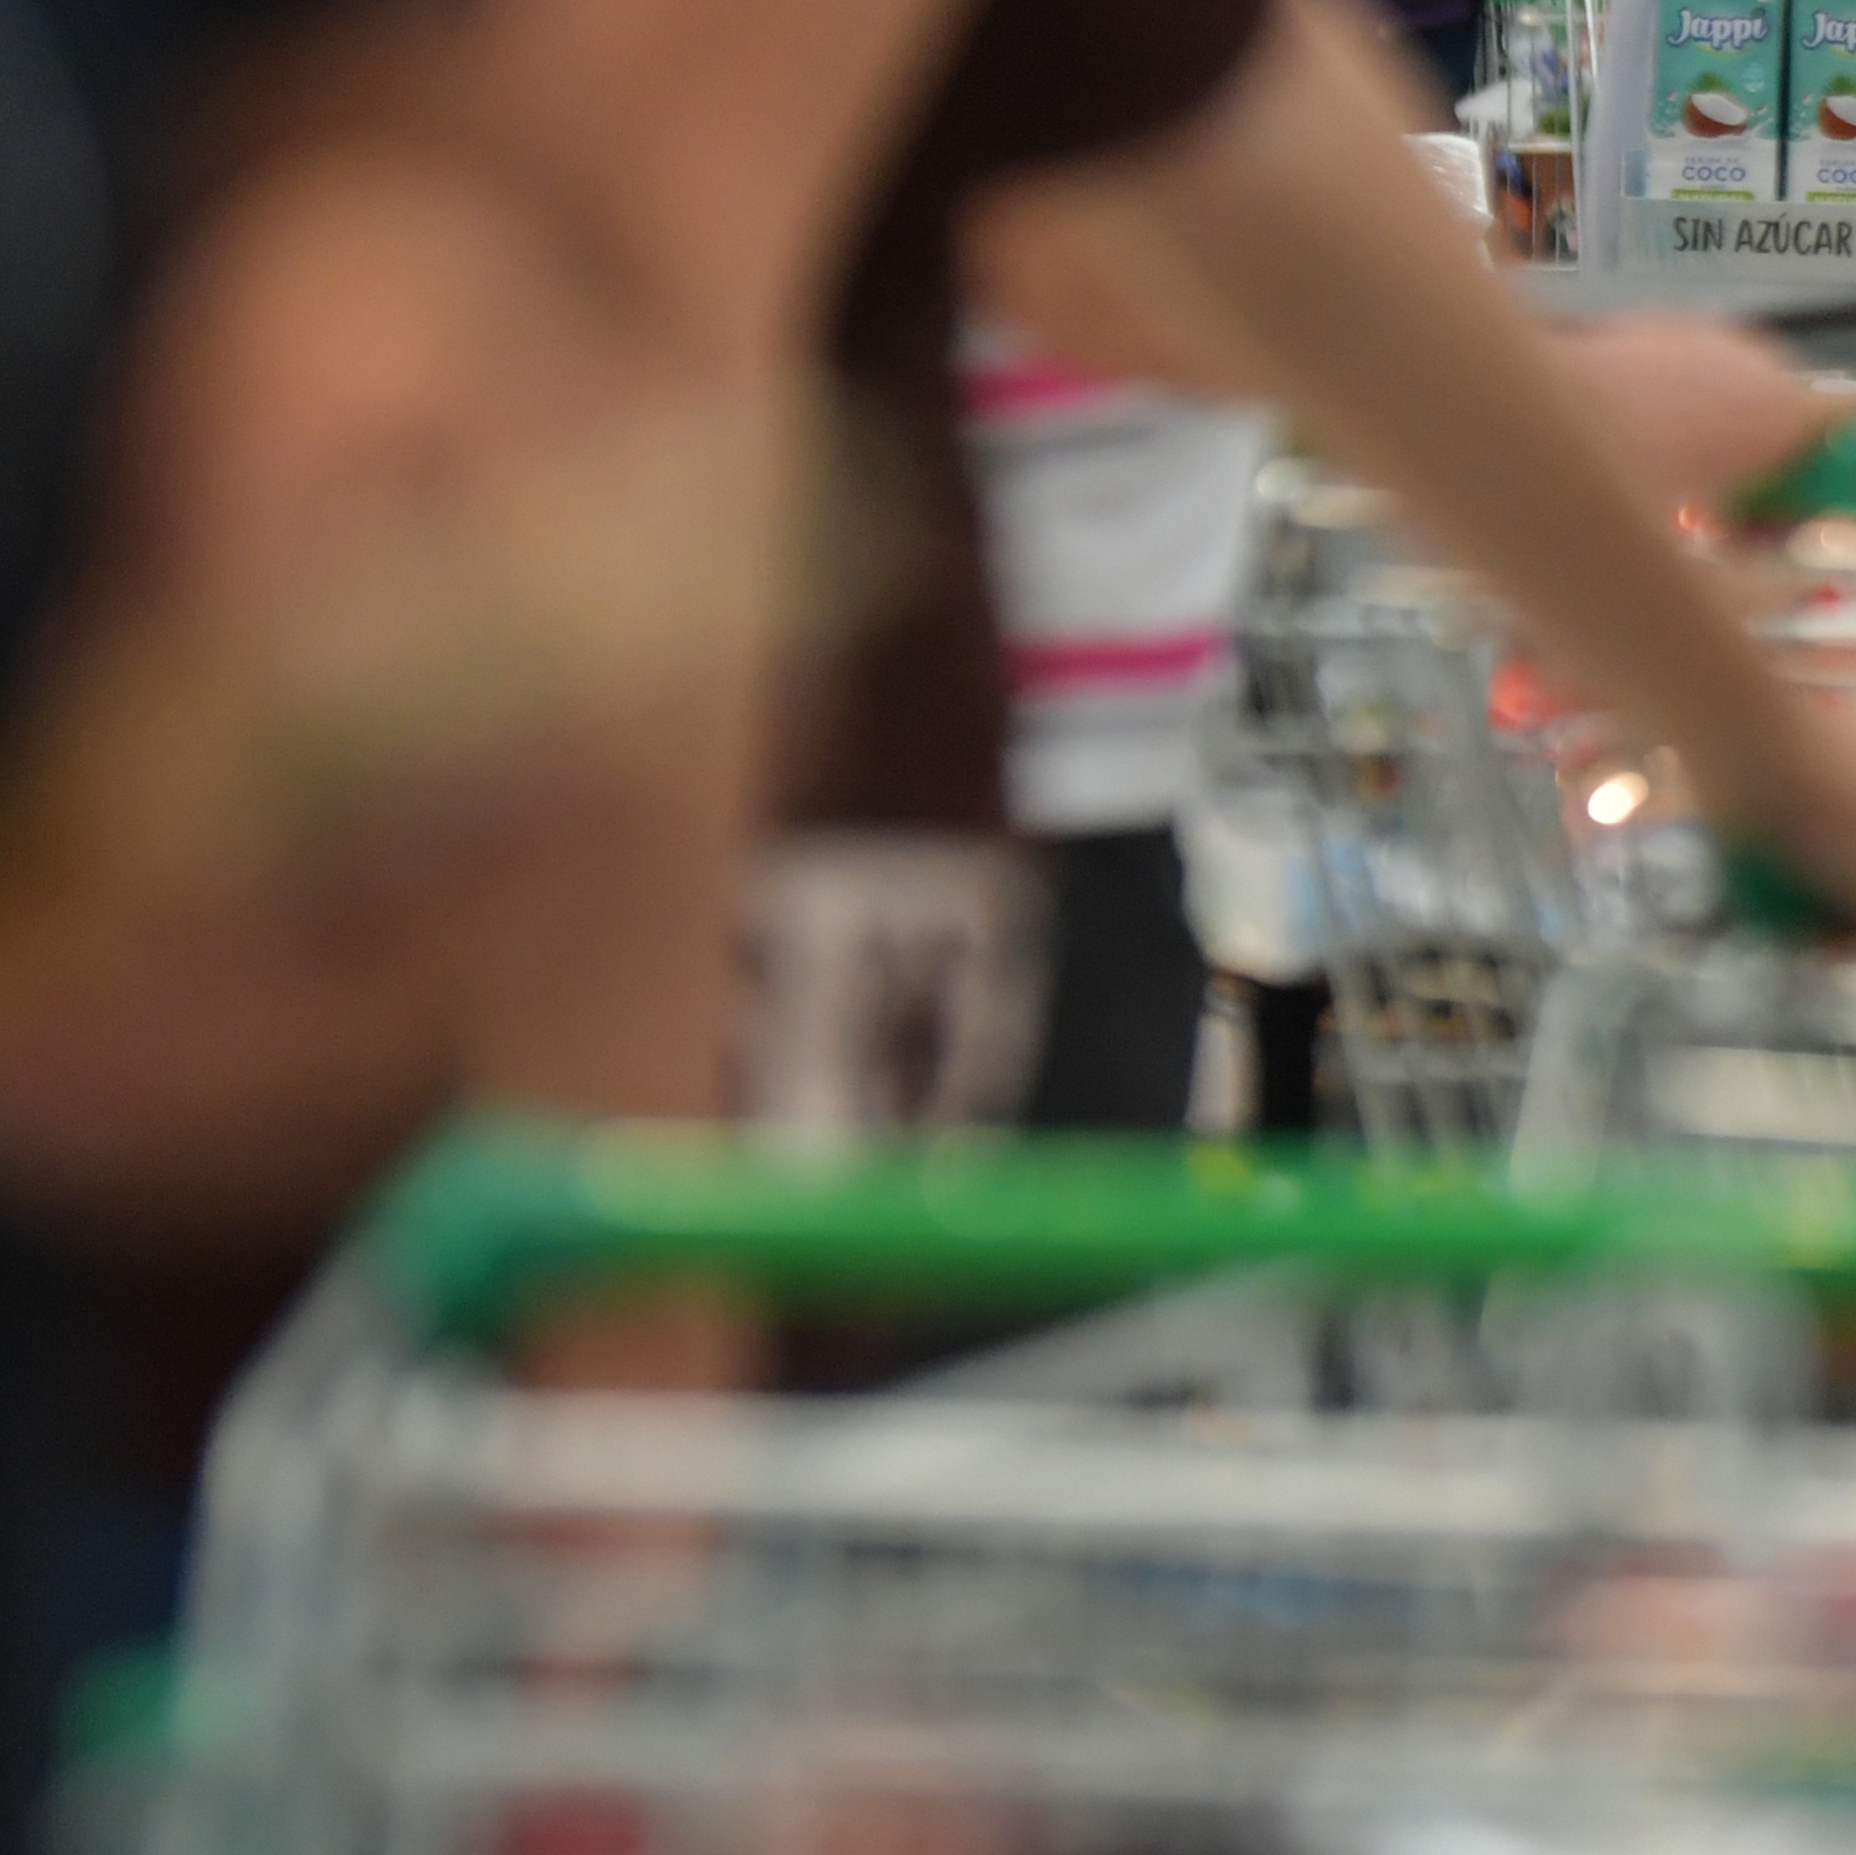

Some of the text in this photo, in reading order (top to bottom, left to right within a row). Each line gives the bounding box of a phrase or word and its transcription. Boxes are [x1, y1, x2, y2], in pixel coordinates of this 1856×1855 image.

[1667, 8, 1768, 51] Jappi
[1681, 166, 1746, 182] COCO
[1672, 216, 1724, 253] SIN
[1734, 212, 1853, 258] AZÚCAR
